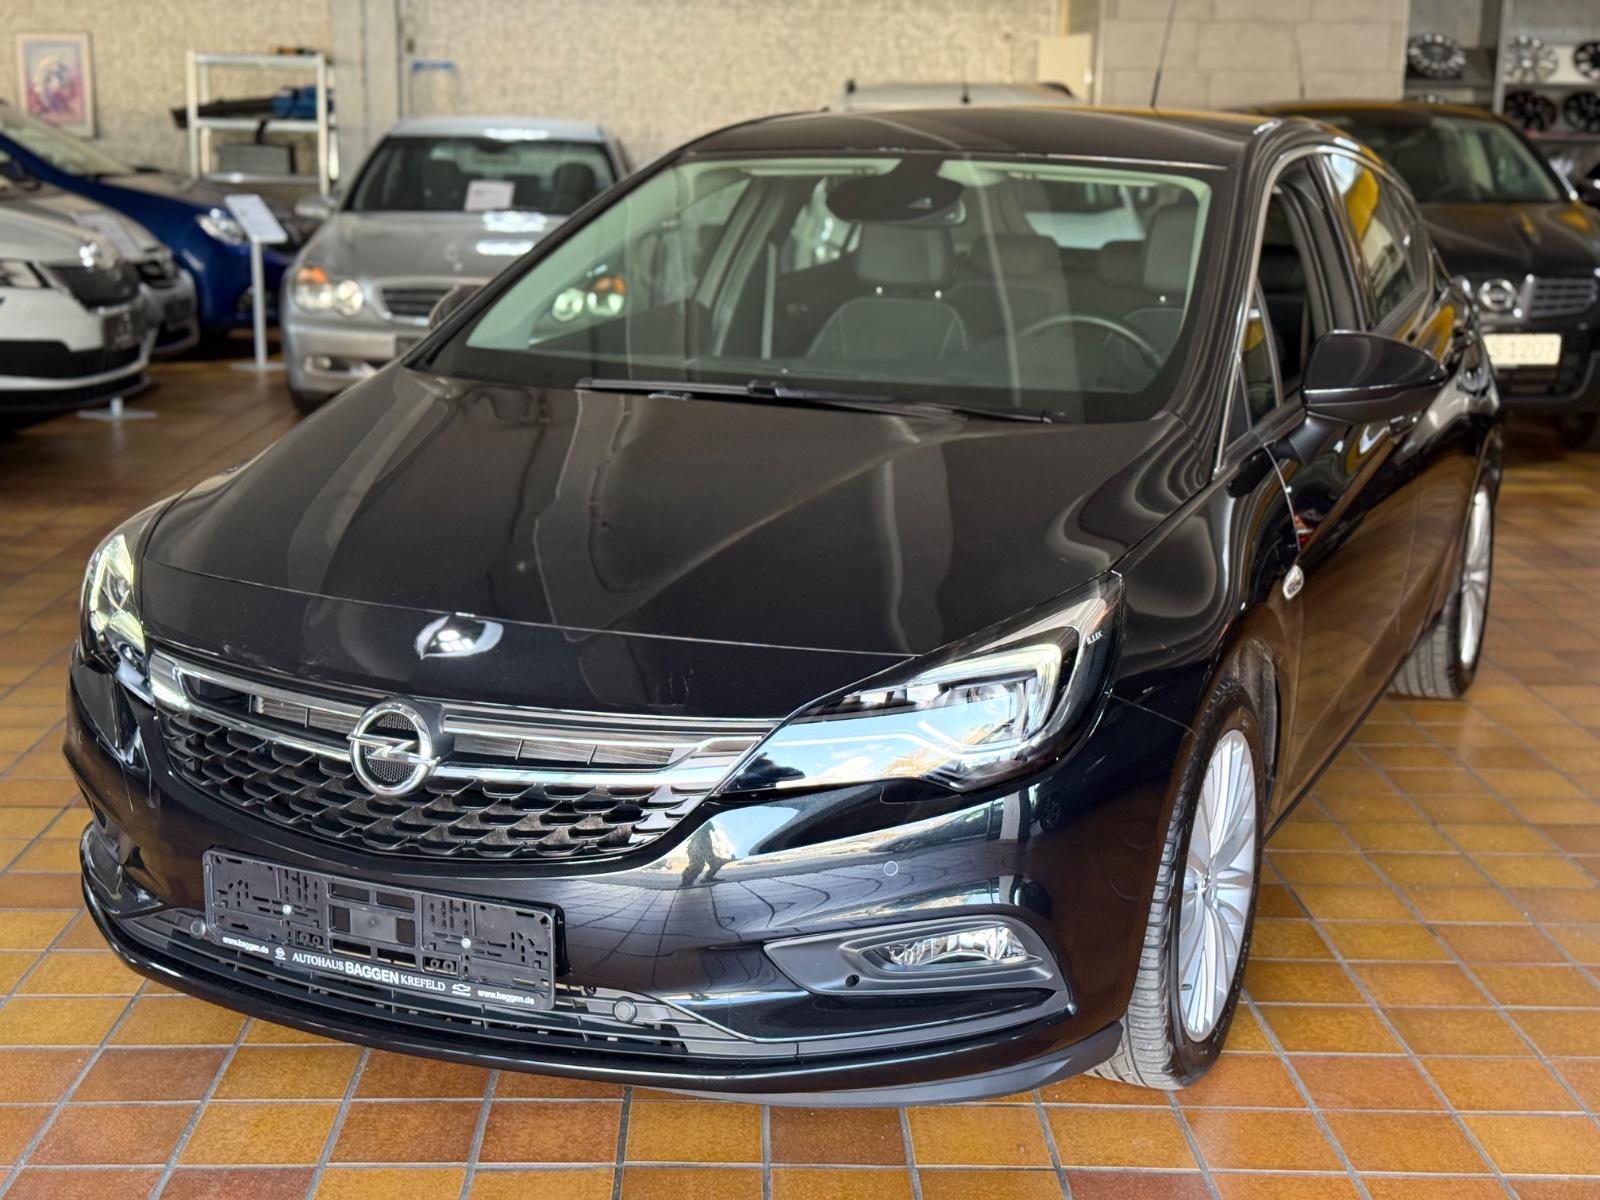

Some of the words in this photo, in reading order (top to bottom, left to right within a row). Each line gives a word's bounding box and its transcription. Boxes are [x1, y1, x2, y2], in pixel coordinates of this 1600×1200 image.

[222, 936, 270, 955] www.baggen.de
[292, 952, 345, 971] AUTOHAUS
[345, 961, 400, 985] BAGGEN
[400, 975, 446, 992] KREFELD
[477, 989, 535, 1005] www.baggen.de
